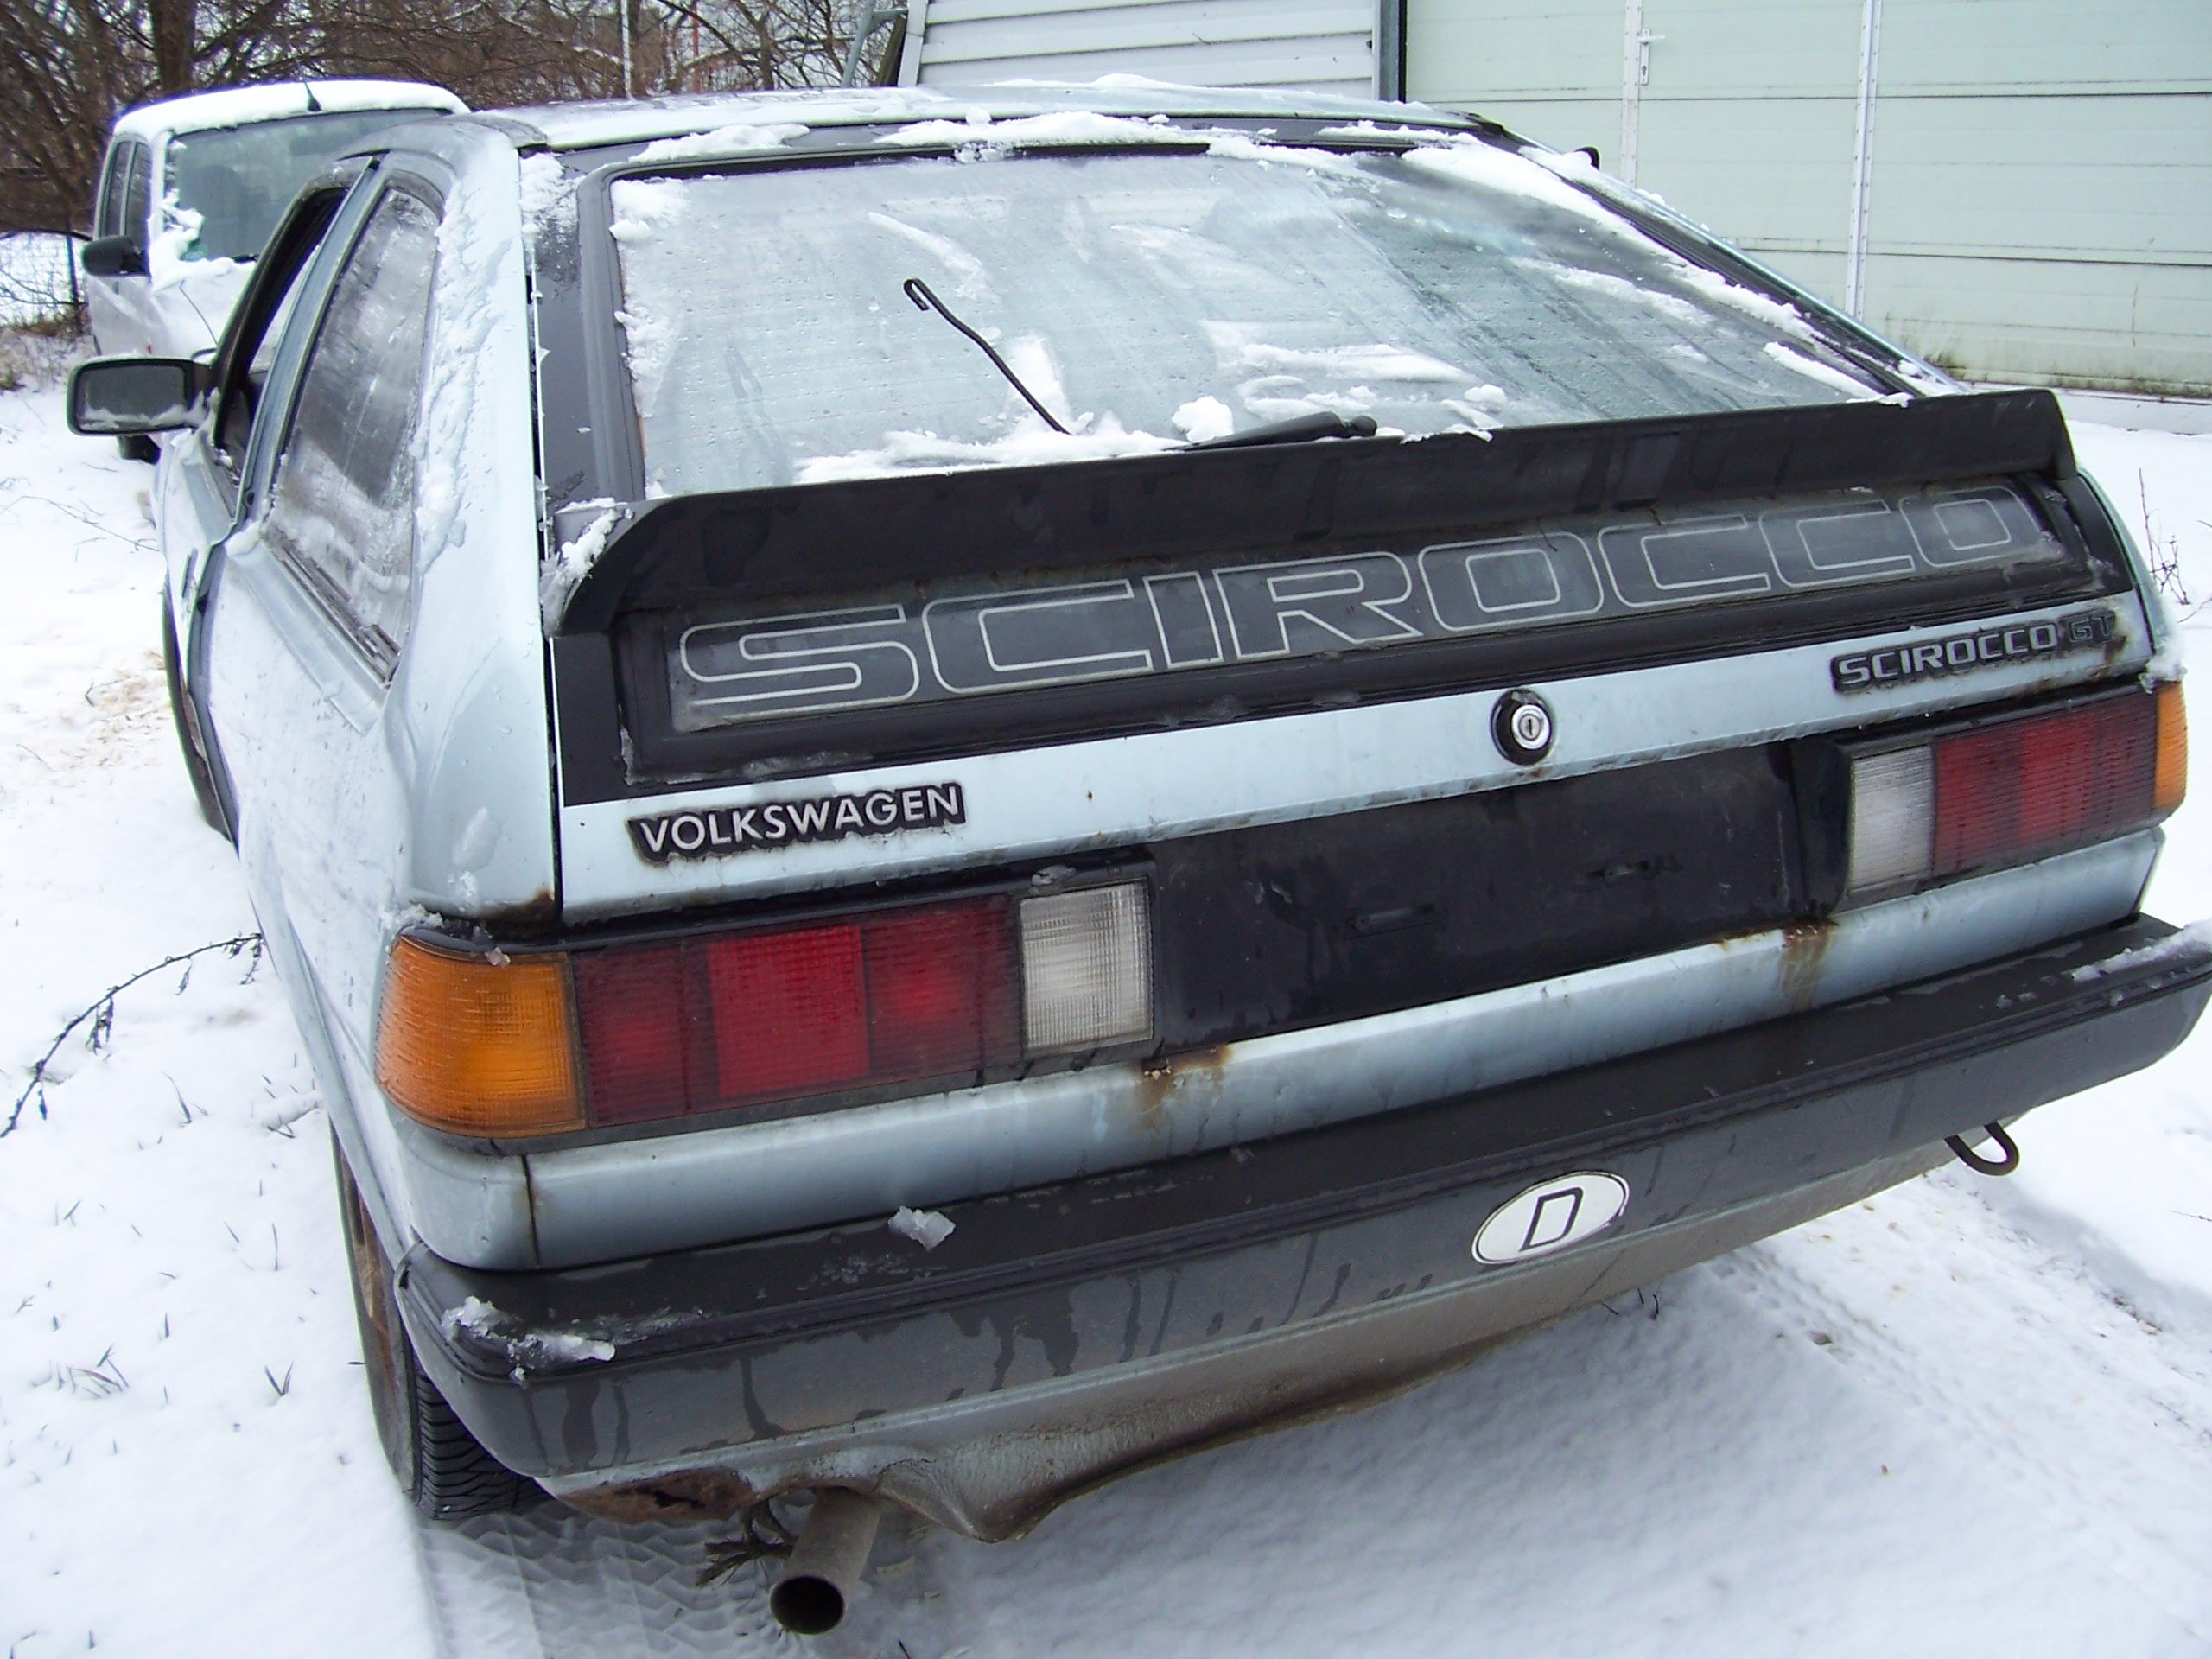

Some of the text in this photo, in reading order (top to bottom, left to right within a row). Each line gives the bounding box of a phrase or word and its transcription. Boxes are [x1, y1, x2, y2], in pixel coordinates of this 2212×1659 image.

[678, 485, 2042, 722] SCIROCCO
[1838, 613, 2115, 685] SCIROCCO GT
[640, 785, 959, 854] VOLKSWAGEN
[1518, 1186, 1584, 1252] D
